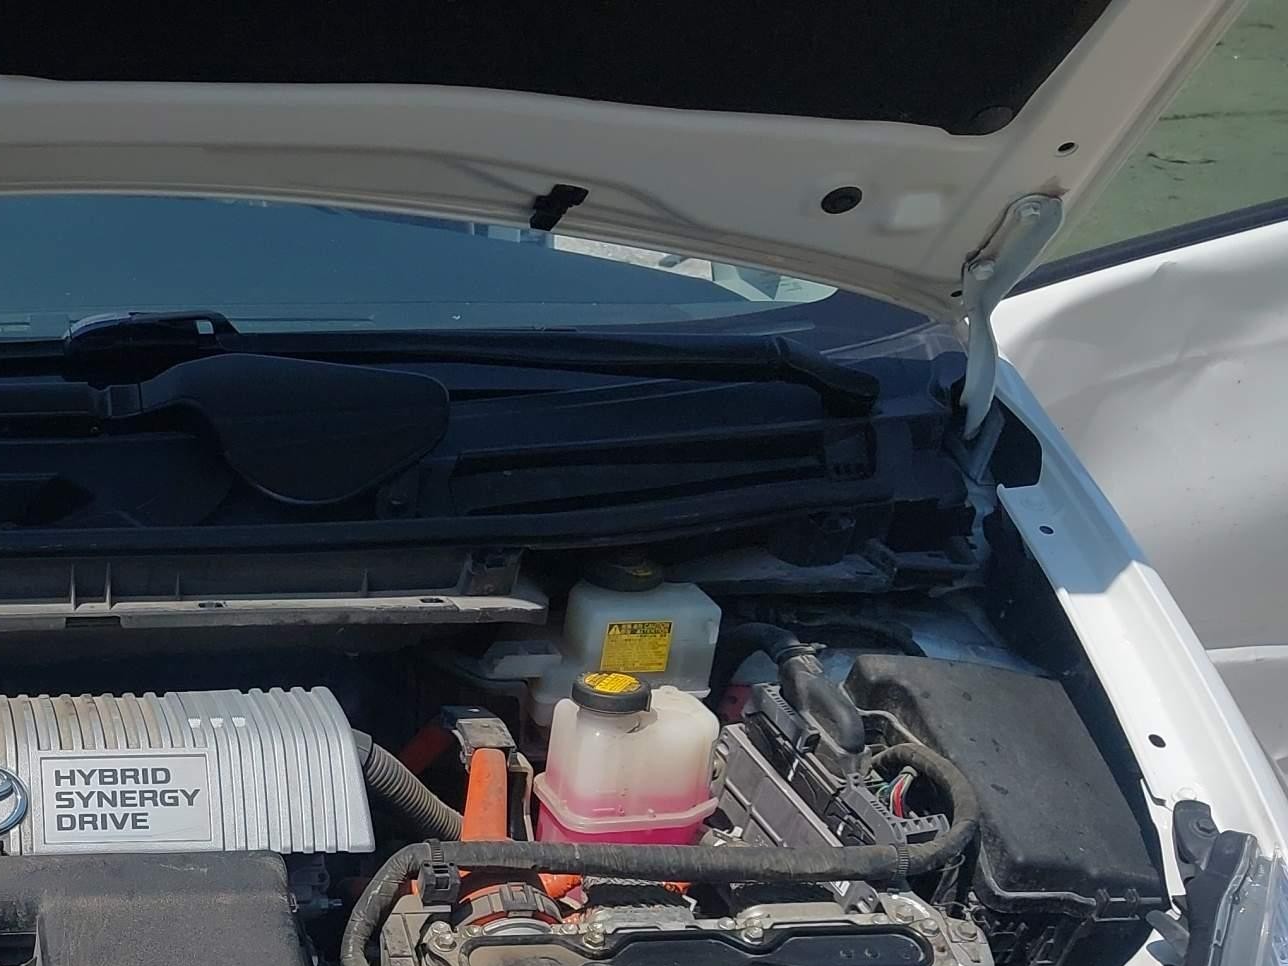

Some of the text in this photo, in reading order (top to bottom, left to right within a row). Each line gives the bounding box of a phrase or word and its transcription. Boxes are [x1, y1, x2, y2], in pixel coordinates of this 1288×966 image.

[54, 767, 171, 787] HYBRID
[55, 788, 201, 809] SYNERGY
[56, 812, 150, 832] DRIVE
